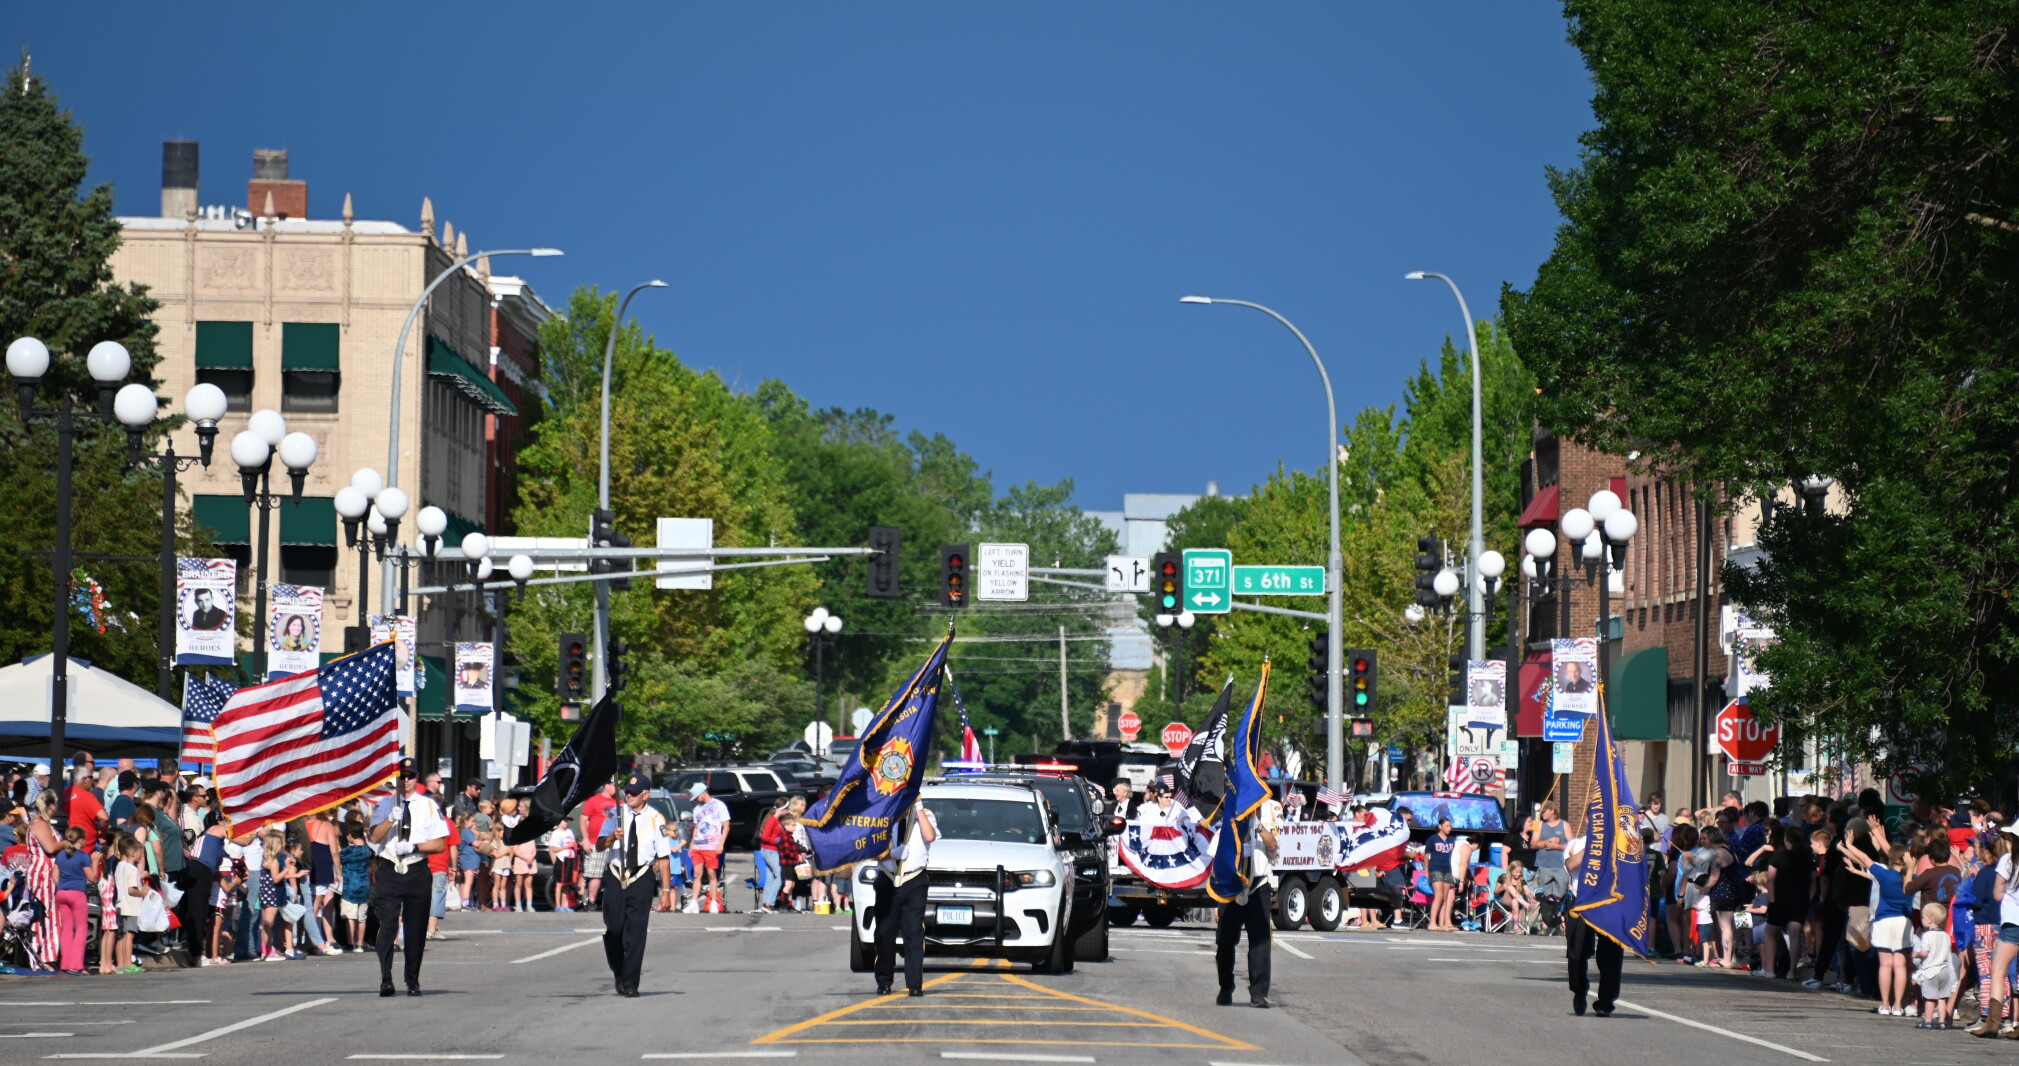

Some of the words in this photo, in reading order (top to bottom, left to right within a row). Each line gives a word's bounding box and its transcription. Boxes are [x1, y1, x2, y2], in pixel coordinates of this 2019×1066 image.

[992, 560, 1016, 568] YIELD
[995, 570, 1025, 578] FLASHING
[1194, 569, 1220, 584] 371
[1244, 576, 1252, 588] S
[1261, 573, 1291, 589] 6th
[1300, 576, 1314, 589] St
[991, 589, 1016, 597] ARROW
[189, 644, 221, 652] HEROES
[1120, 719, 1139, 728] STOP
[1546, 720, 1581, 729] PARKING
[1720, 717, 1775, 742] STOP
[1163, 730, 1189, 744] STOP
[1459, 745, 1479, 753] ONLY
[1731, 765, 1745, 774] ALL
[1749, 765, 1764, 774] WAY
[1590, 780, 1604, 810] OUNTY
[841, 814, 890, 828] VETERANS
[1292, 825, 1308, 836] POST
[1589, 812, 1605, 857] CHAPTER
[855, 838, 867, 850] OF
[871, 830, 887, 845] THE
[1282, 856, 1315, 866] AUXILIARY
[1583, 872, 1599, 887] 22
[942, 911, 967, 921] POLICE
